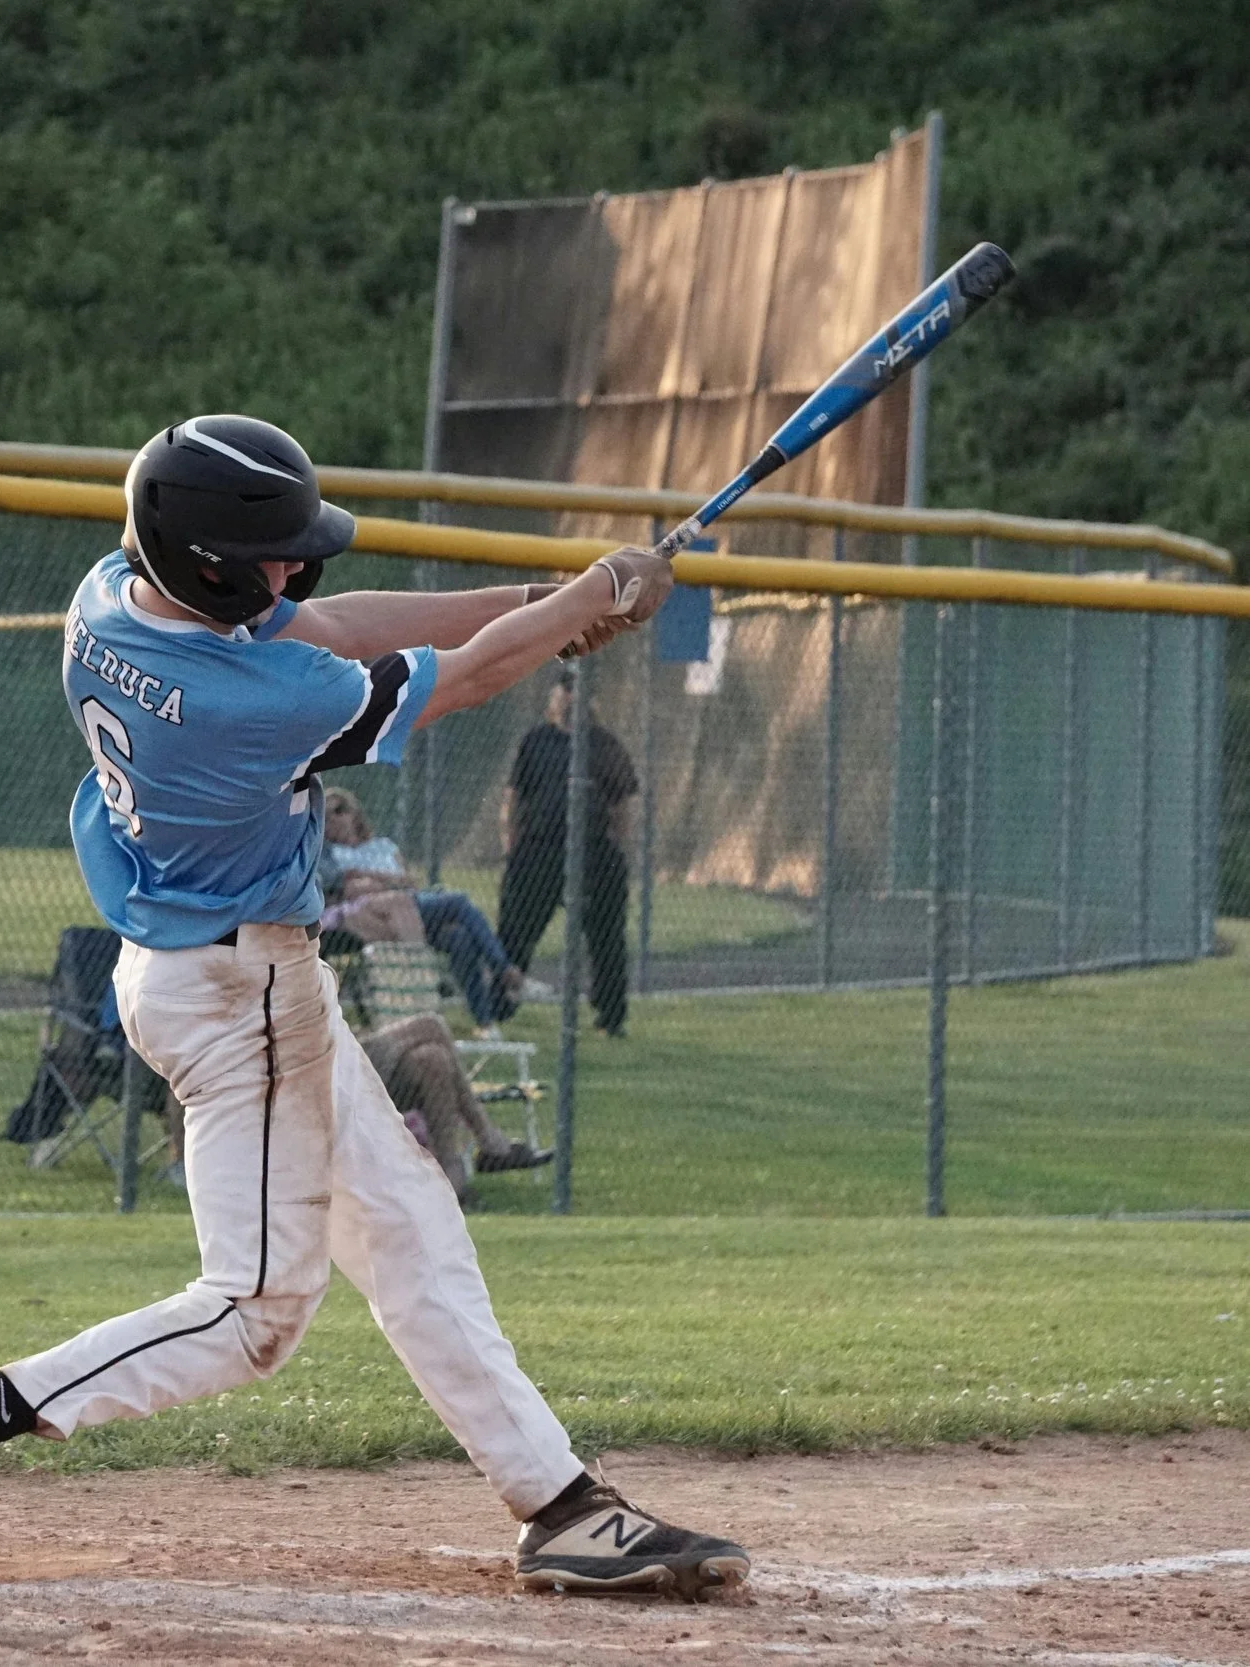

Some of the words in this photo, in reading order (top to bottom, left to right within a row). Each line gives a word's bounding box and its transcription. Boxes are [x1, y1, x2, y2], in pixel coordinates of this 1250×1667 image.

[874, 300, 950, 379] META
[189, 544, 222, 563] ELITE
[80, 695, 143, 838] 6
[589, 1512, 650, 1549] N
